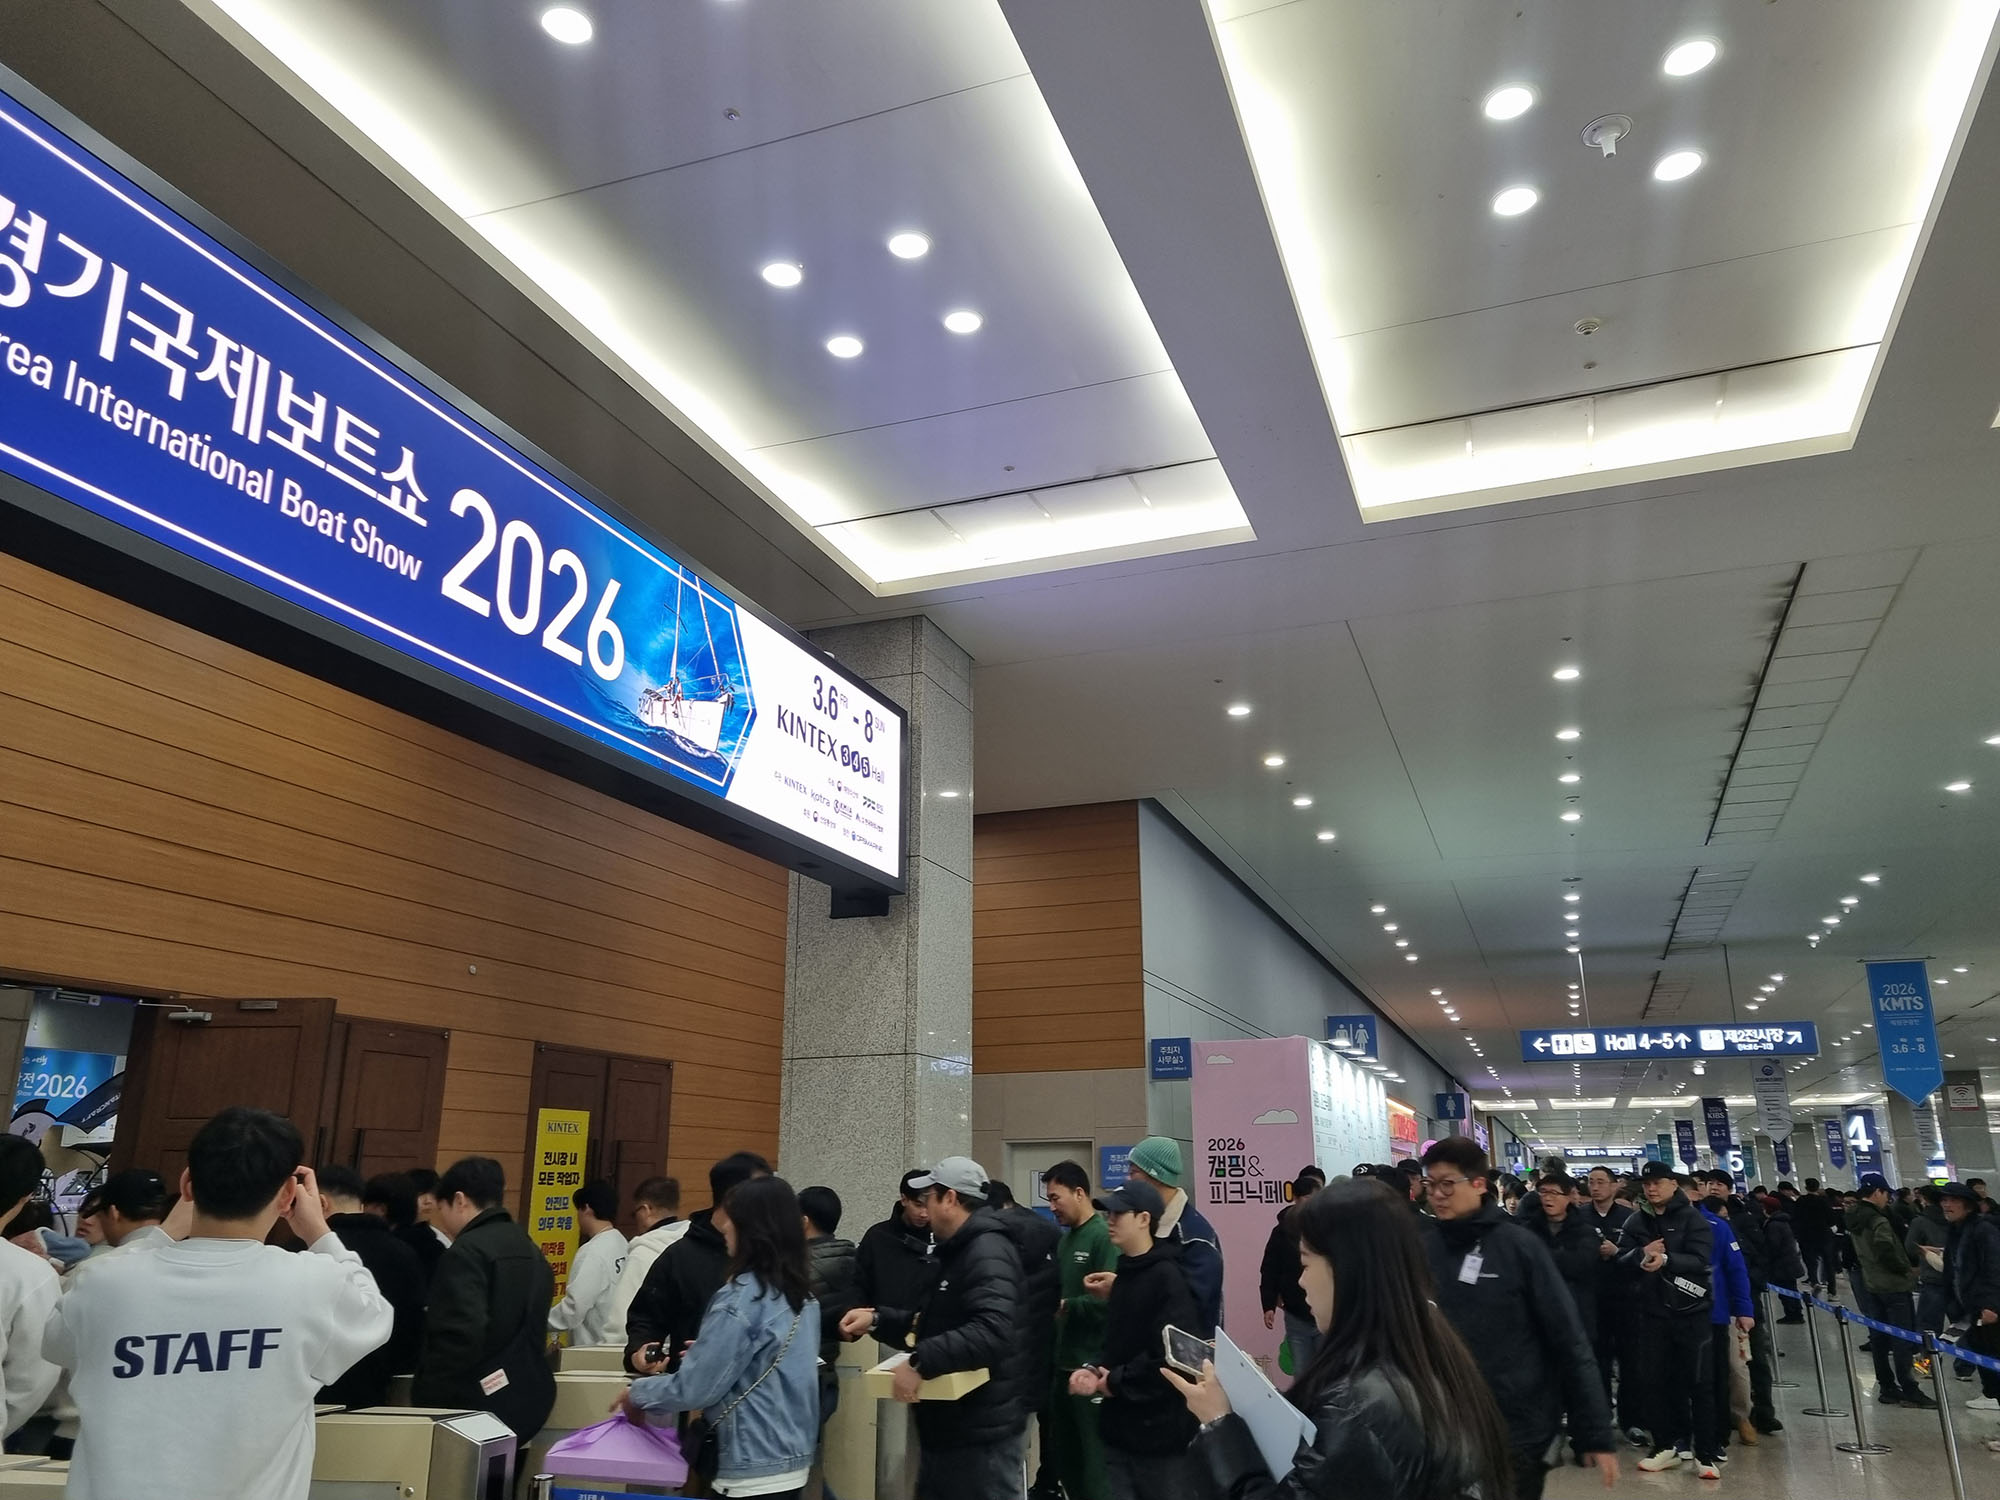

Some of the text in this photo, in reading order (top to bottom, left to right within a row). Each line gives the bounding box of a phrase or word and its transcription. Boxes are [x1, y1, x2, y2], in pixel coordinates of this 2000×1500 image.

[0, 195, 625, 681] 경기국제보트쇼 2026
[0, 333, 422, 580] rea International Boat Show
[813, 675, 838, 720] 3.6
[777, 704, 837, 761] KINTEX
[871, 765, 884, 784] Hall
[811, 788, 831, 807] kotra
[1883, 983, 1916, 996] 2026
[1880, 996, 1924, 1011] KMTS
[1605, 1034, 1637, 1051] Hall
[1723, 1028, 1784, 1044] 제2전시장
[1160, 1046, 1181, 1055] 주최자
[1157, 1055, 1184, 1065] 사무실3
[34, 1073, 88, 1099] 2026
[548, 1121, 579, 1133] KINTEX
[1849, 1115, 1873, 1152] 4
[1208, 1138, 1245, 1151] 2026
[544, 1151, 578, 1166] 전시장 내
[1730, 1151, 1745, 1172] 5
[538, 1171, 580, 1186] 모든 작업자
[545, 1196, 569, 1211] 안전모
[538, 1216, 572, 1231] 의무 착용
[112, 1327, 282, 1379] STAFF
